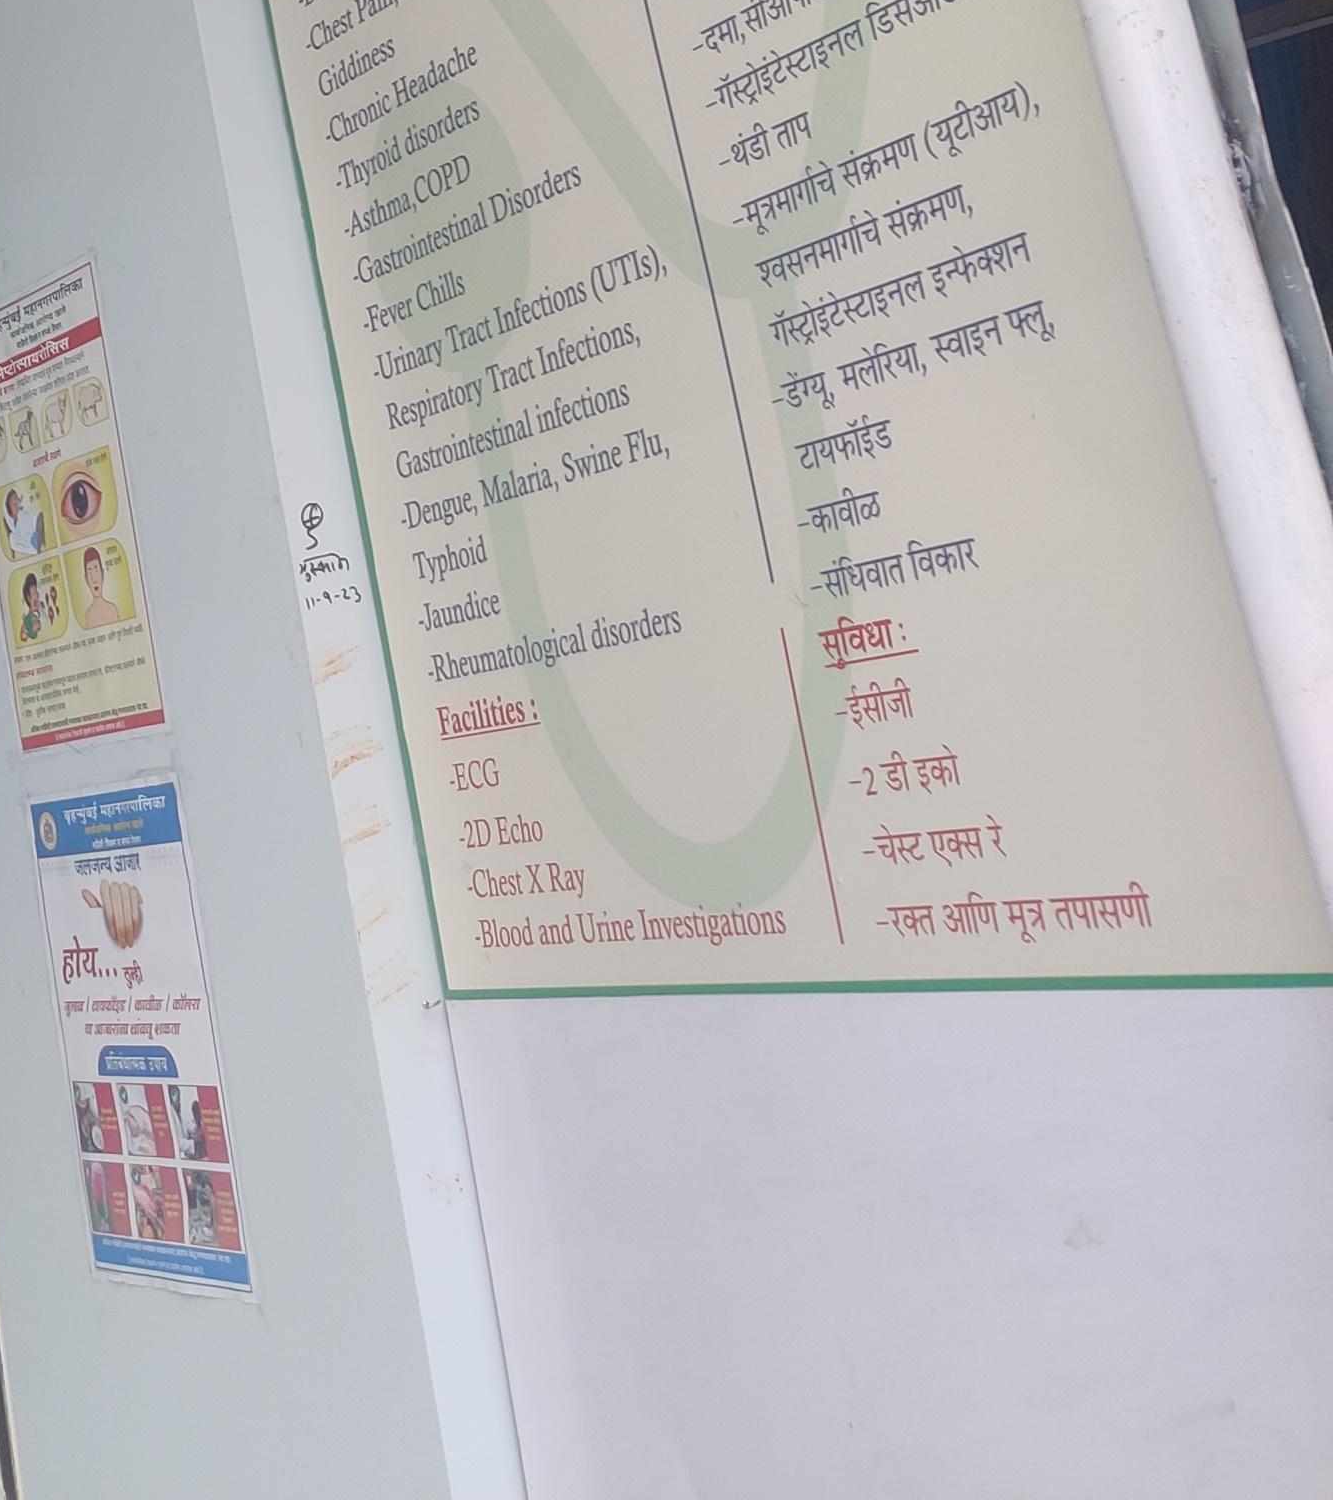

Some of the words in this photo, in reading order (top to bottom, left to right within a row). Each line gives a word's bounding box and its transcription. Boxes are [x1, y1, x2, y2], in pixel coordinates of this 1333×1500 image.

[325, 91, 392, 145] -Chronic
[391, 45, 479, 108] Headache
[335, 136, 402, 190] -Thyroid
[404, 100, 481, 157] disorders
[718, 121, 771, 168] -थंडी
[771, 111, 813, 150] ताप
[363, 298, 414, 334] -Fever
[415, 270, 466, 312] Chills
[373, 337, 443, 380] -Urinary
[444, 318, 494, 355] Tract
[492, 280, 588, 336] Infections
[589, 244, 668, 303] (UTIs),
[797, 488, 881, 534] -कावीळ
[810, 555, 906, 599] -संधिवात
[906, 539, 980, 581] विकार
[417, 590, 501, 633] -Jaundice
[817, 615, 894, 670] सुविधा
[436, 697, 526, 737] Facilities
[835, 678, 914, 731] -ईसीजी
[449, 758, 501, 792] -ECG
[459, 817, 492, 849] -2D
[494, 814, 544, 845] Echo
[862, 824, 925, 866] -चेस्ट
[926, 827, 984, 868] एक्स
[986, 814, 1007, 857] रे
[466, 866, 523, 900] -Chest
[525, 864, 547, 894] X
[546, 862, 586, 899] Ray
[474, 917, 534, 950] -Blood
[539, 914, 575, 946] and
[575, 910, 635, 944] Urine
[637, 902, 787, 947] Investigations
[876, 905, 935, 937] -रक्त
[942, 891, 1000, 935] आणि
[1002, 899, 1047, 944] मूत्र
[1048, 880, 1153, 931] तपासणी
